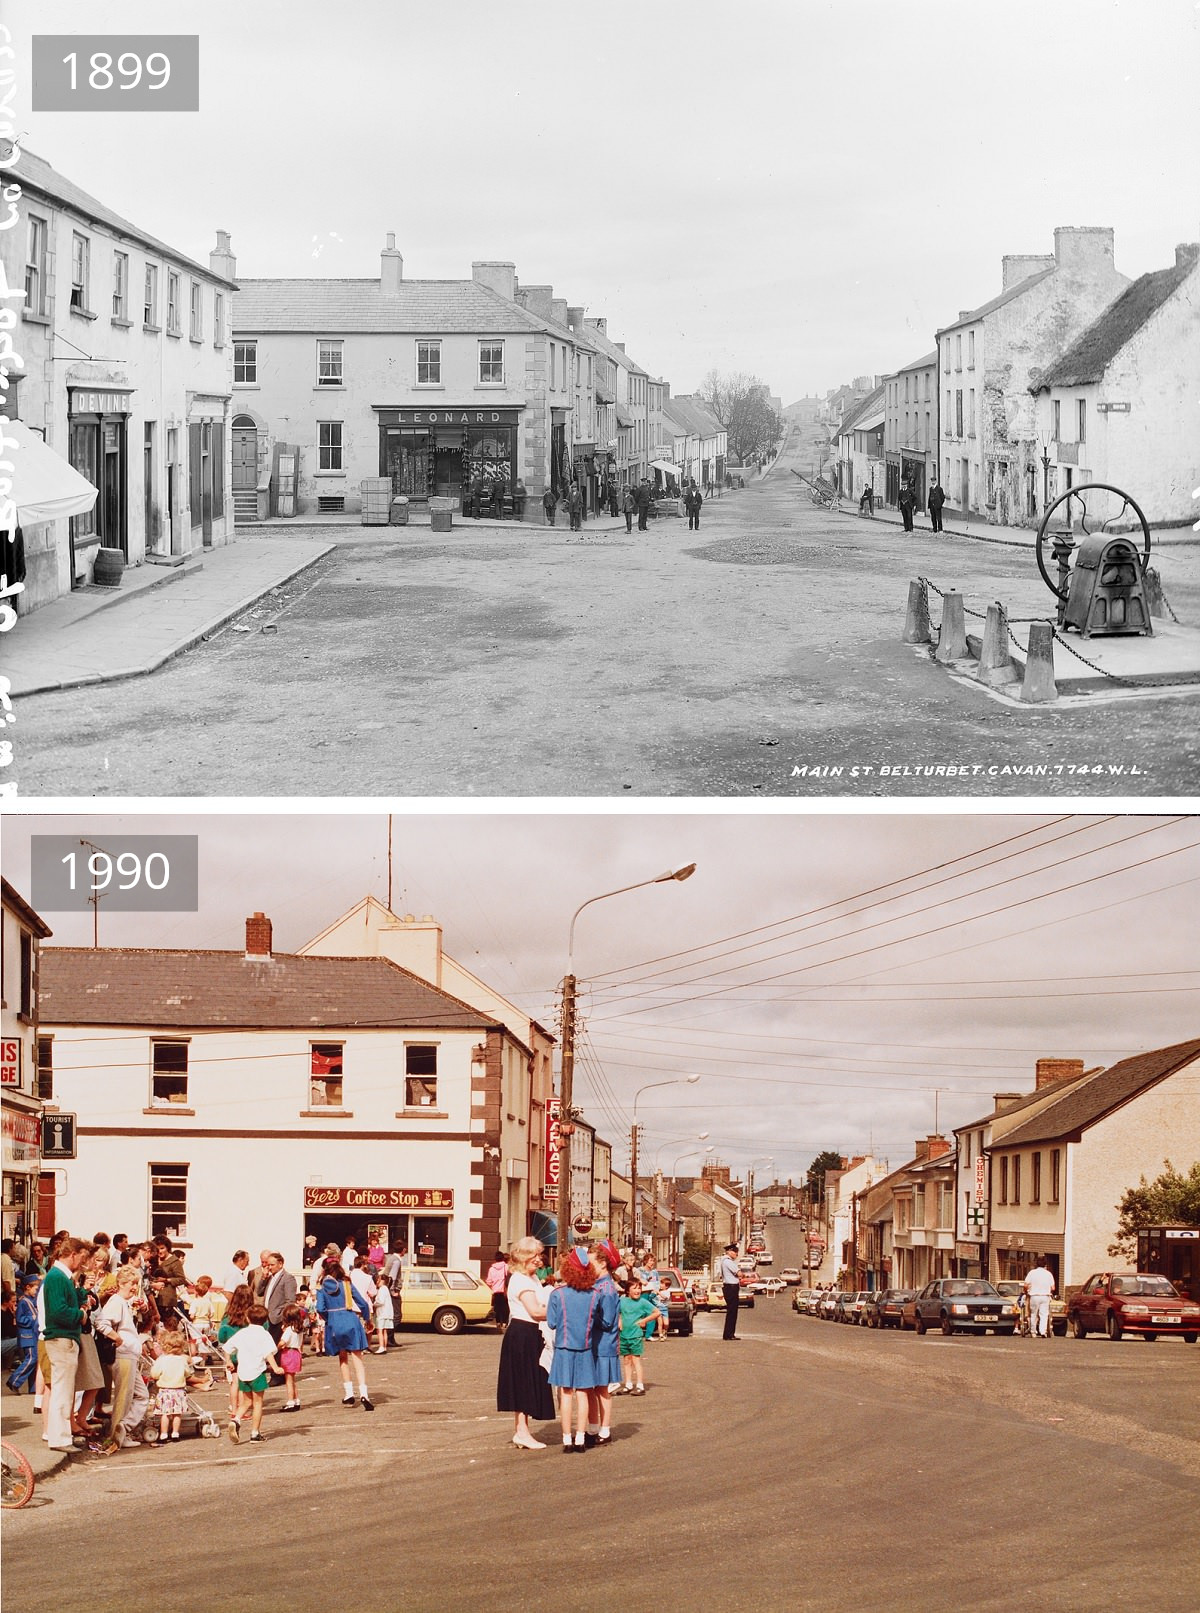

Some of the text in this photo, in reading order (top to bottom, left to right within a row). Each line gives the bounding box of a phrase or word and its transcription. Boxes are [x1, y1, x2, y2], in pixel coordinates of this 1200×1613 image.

[79, 393, 127, 411] DEVINE
[398, 412, 500, 423] LEONARD
[976, 1158, 984, 1201] CHEMIST
[346, 1190, 387, 1205] Coffee
[390, 1190, 419, 1207] Stop
